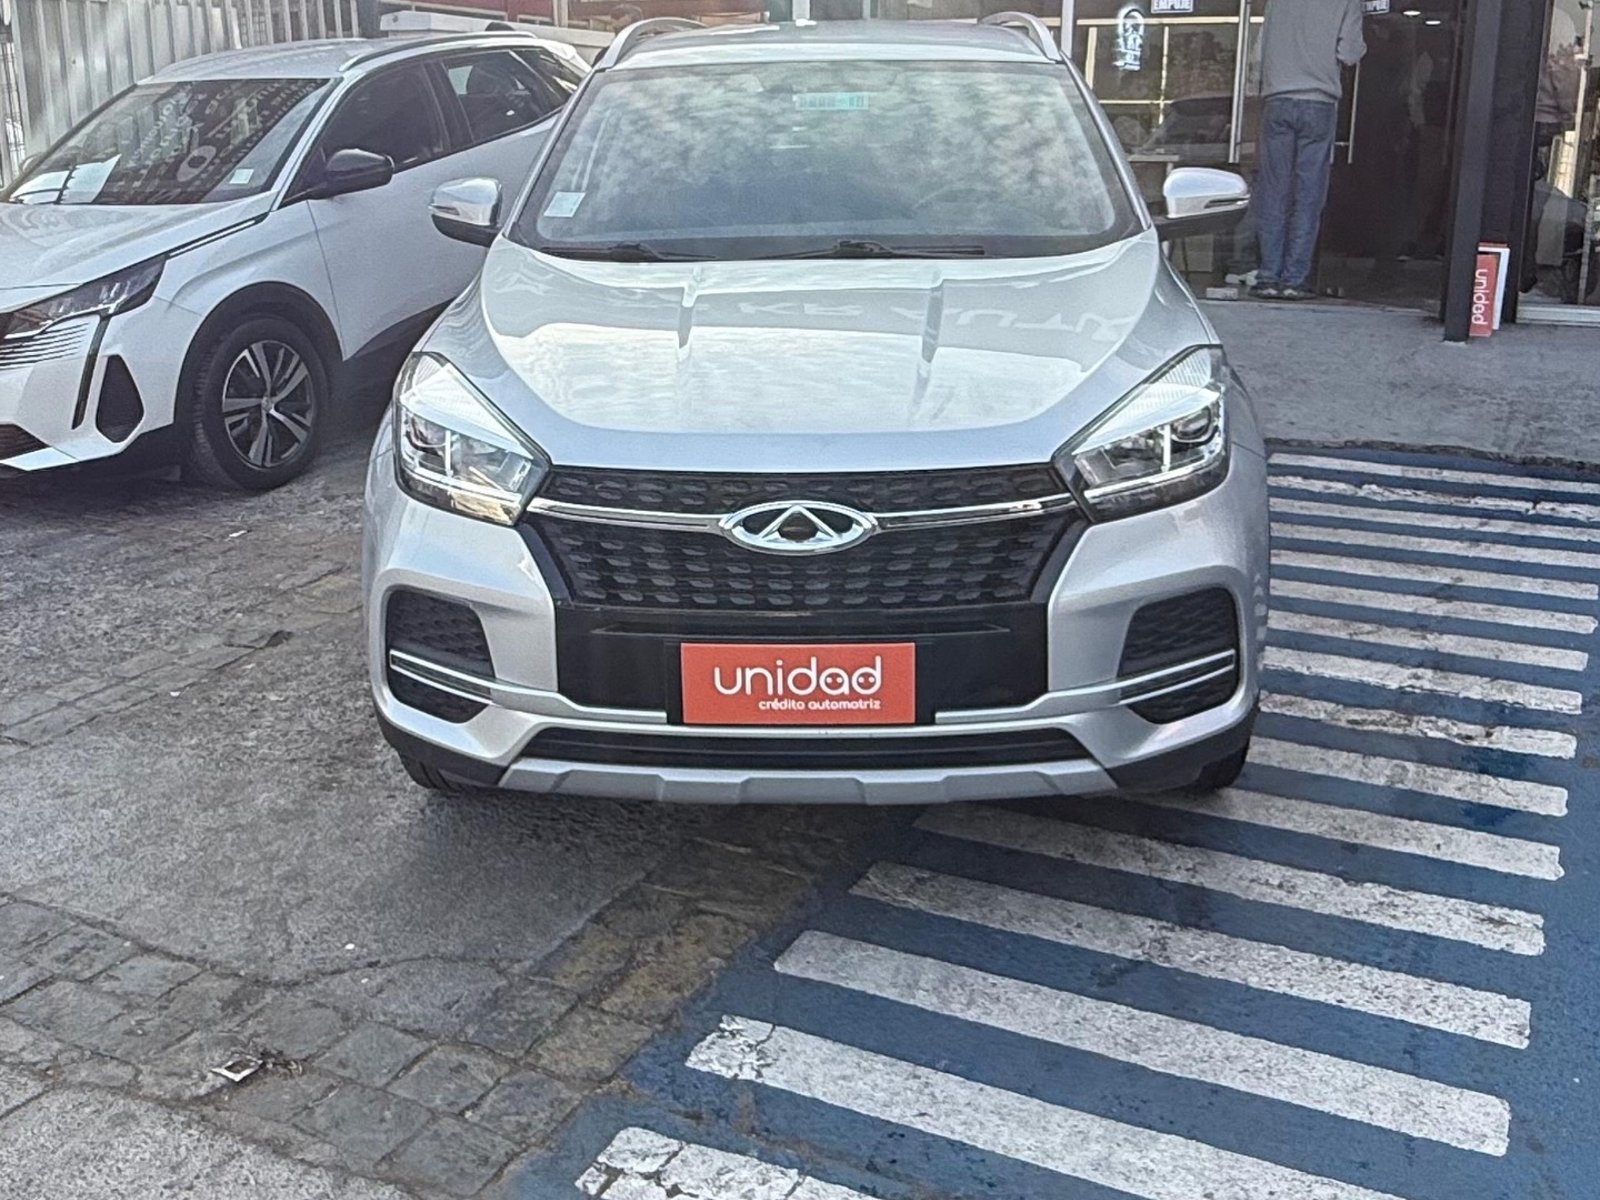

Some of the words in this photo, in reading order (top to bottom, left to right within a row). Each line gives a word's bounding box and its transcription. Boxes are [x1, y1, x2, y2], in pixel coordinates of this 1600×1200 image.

[1471, 268, 1490, 325] unidad
[714, 655, 882, 696] unidad
[758, 698, 805, 711] crédito
[807, 699, 881, 711] automotriz
